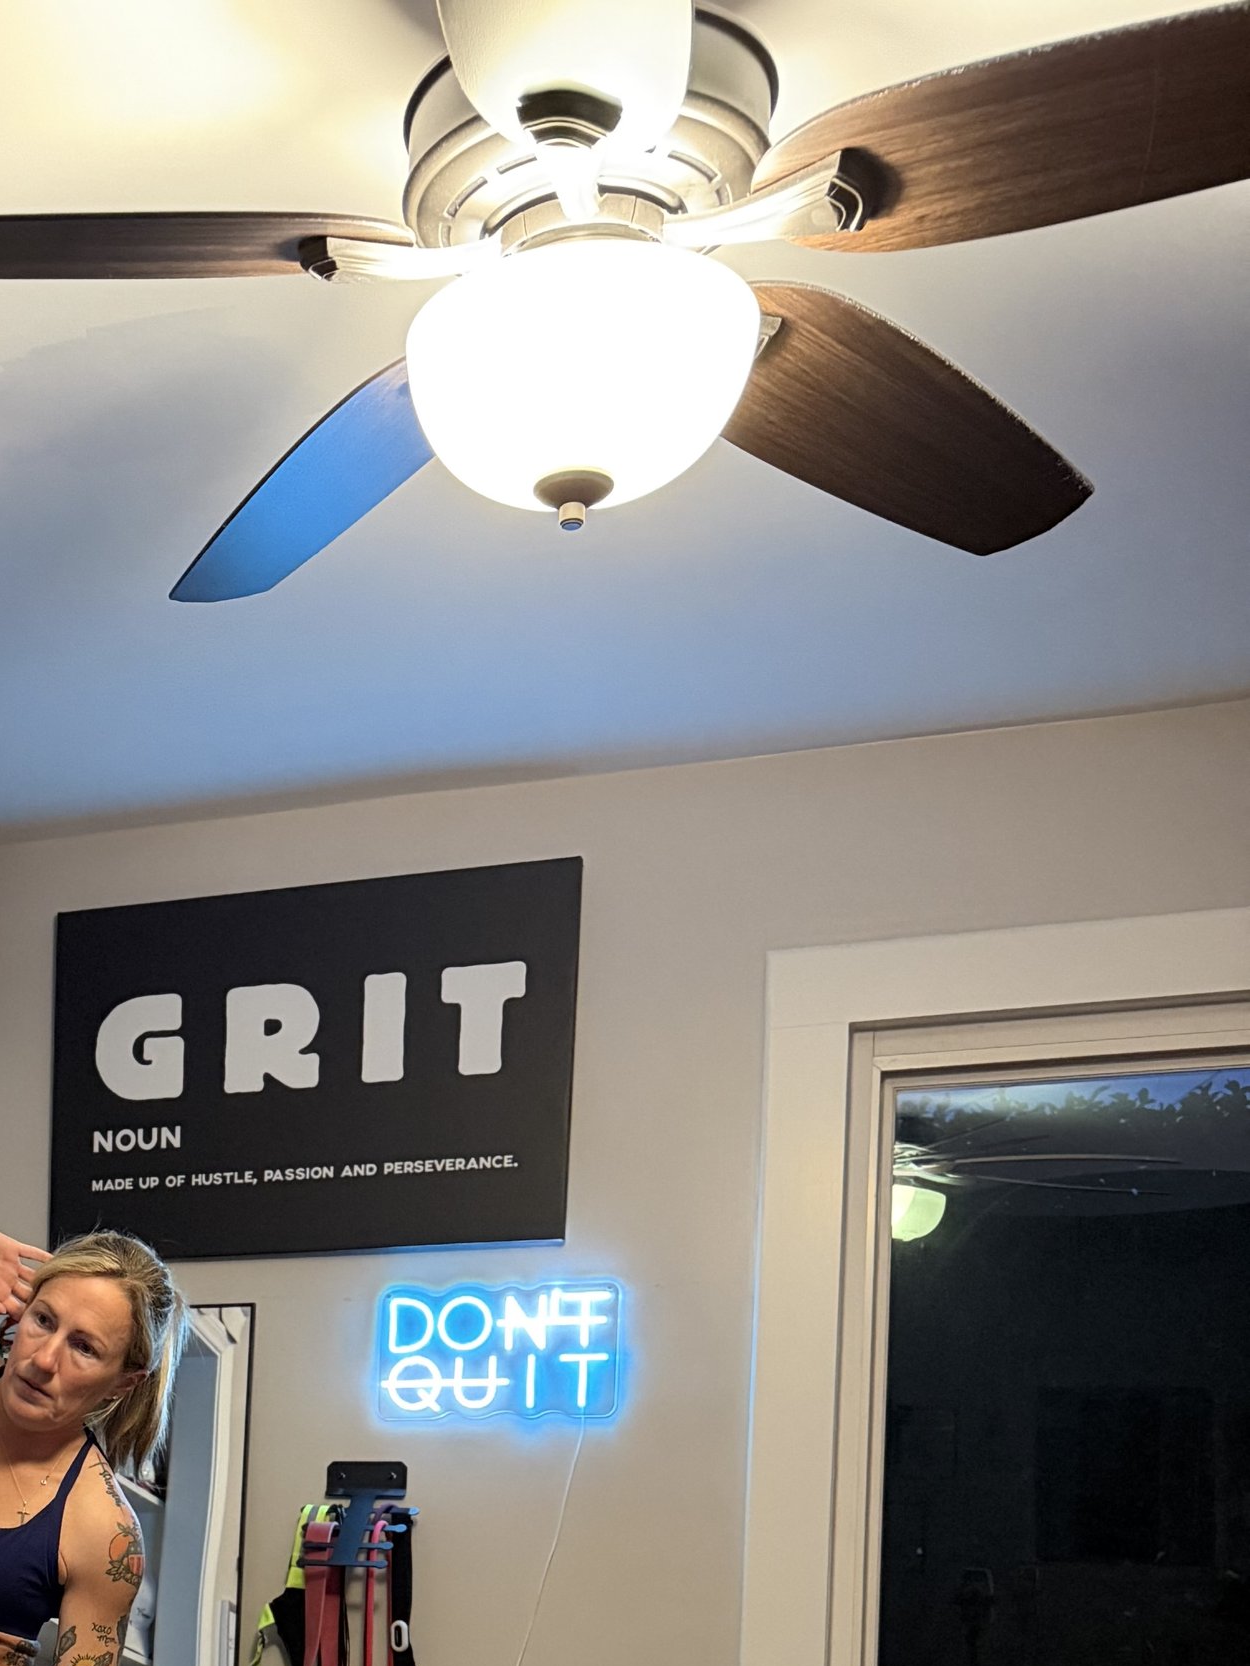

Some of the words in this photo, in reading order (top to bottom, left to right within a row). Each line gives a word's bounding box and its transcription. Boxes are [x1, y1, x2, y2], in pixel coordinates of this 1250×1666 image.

[95, 960, 528, 1101] GRIT
[92, 1125, 182, 1154] NOUN
[91, 1178, 134, 1192] MADE
[139, 1177, 160, 1191] UP
[165, 1175, 186, 1188] OF
[191, 1170, 258, 1187] HUSTLE,
[263, 1165, 335, 1182] PASSION
[340, 1162, 378, 1178] AND
[383, 1154, 519, 1175] PERSEVERANCE.
[382, 1354, 609, 1412] QUIT
